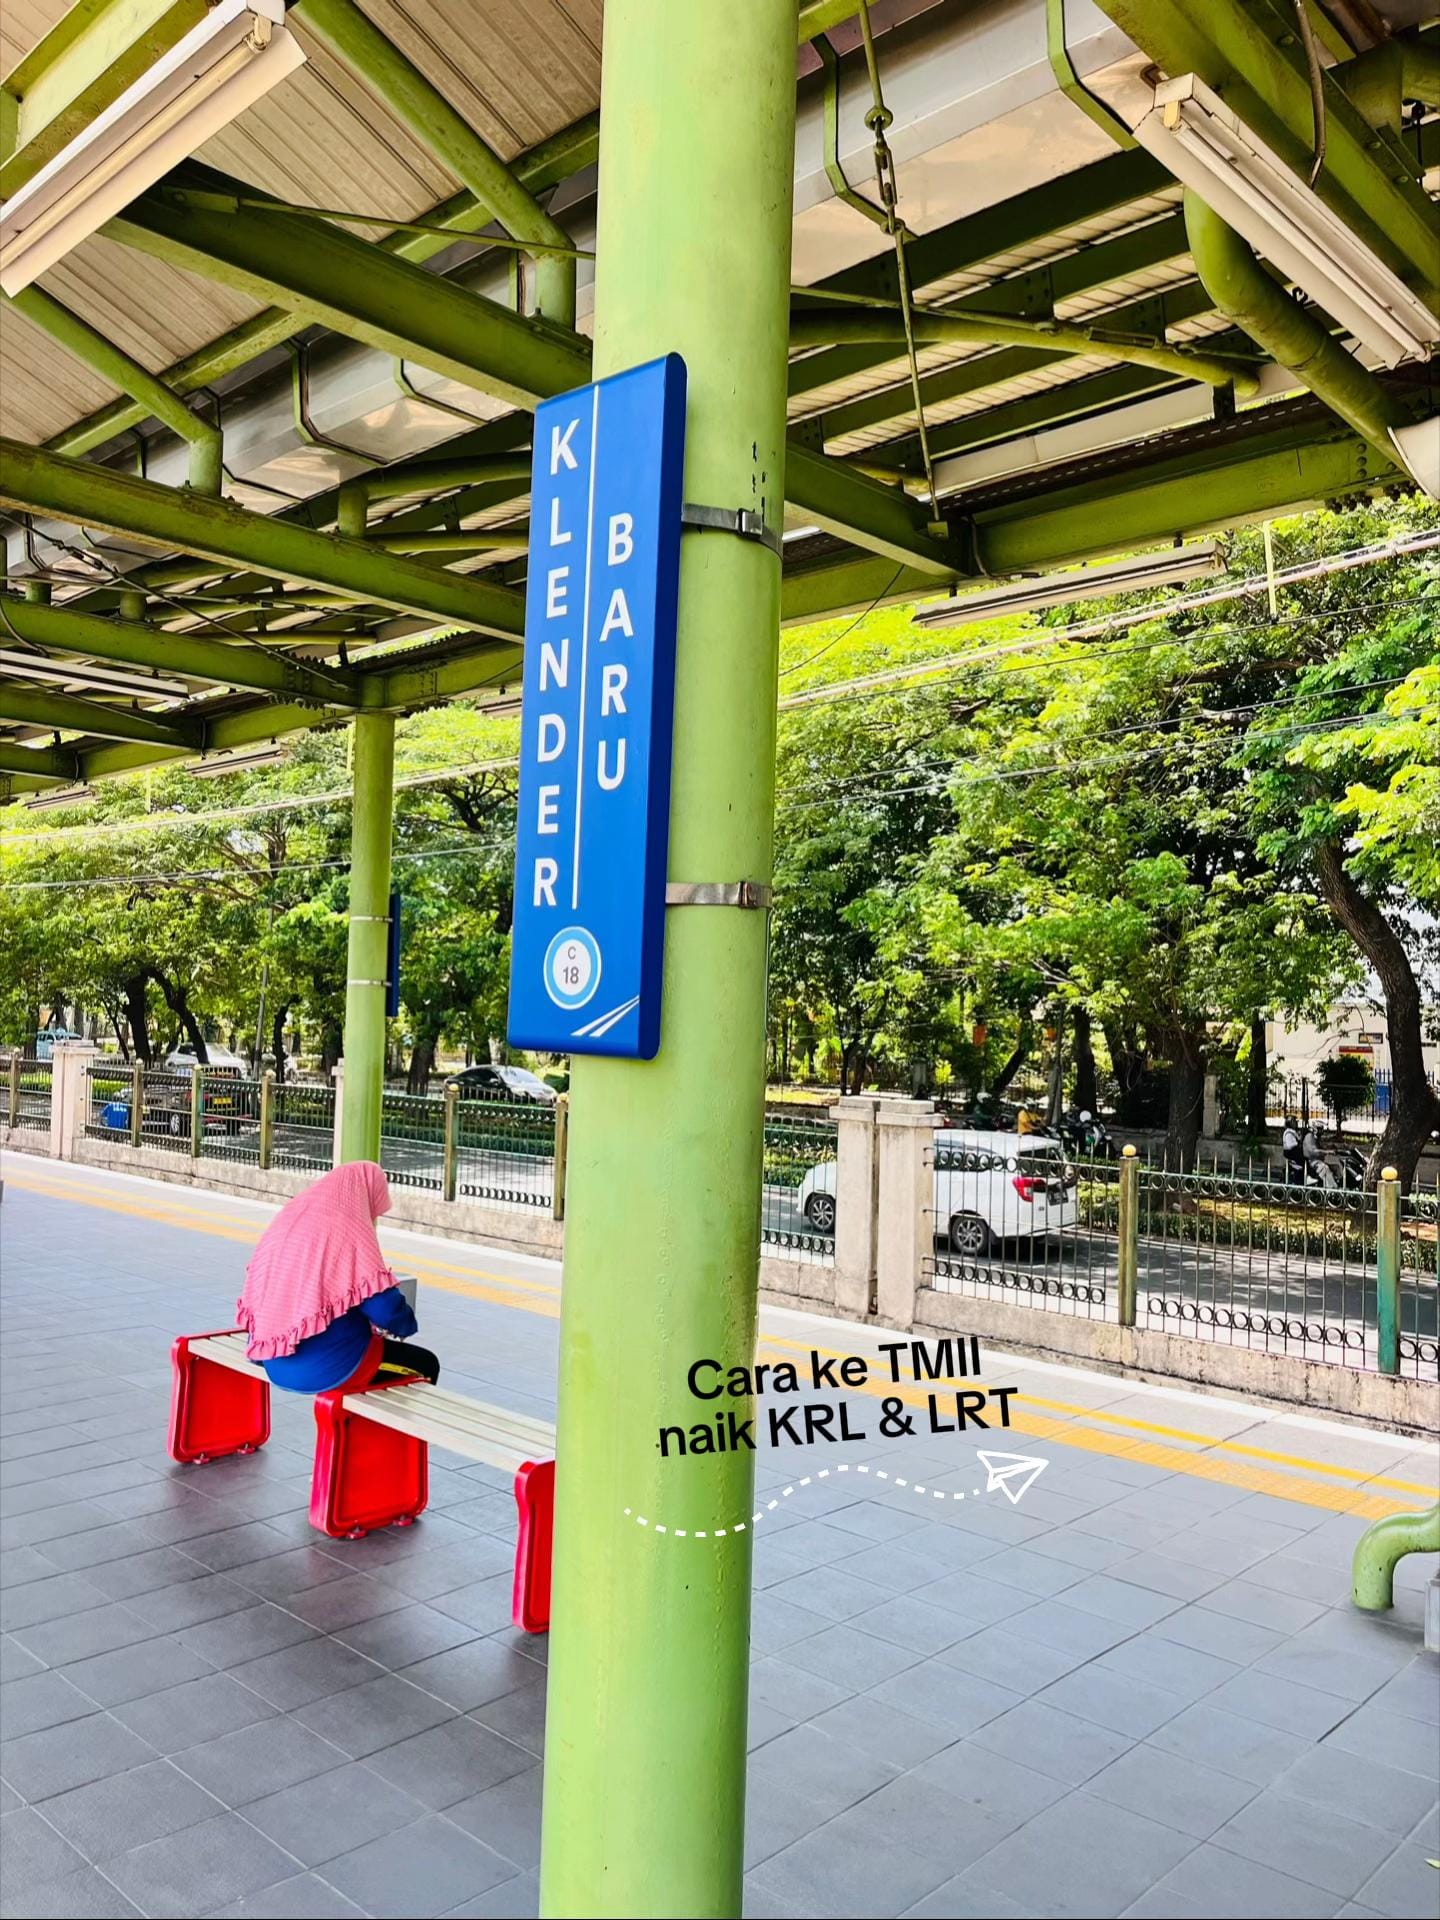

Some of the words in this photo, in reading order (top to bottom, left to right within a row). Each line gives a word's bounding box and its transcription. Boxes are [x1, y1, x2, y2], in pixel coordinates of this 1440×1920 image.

[533, 418, 580, 907] KLENDER
[597, 512, 634, 791] BARU
[562, 966, 580, 985] 18
[567, 945, 577, 960] C
